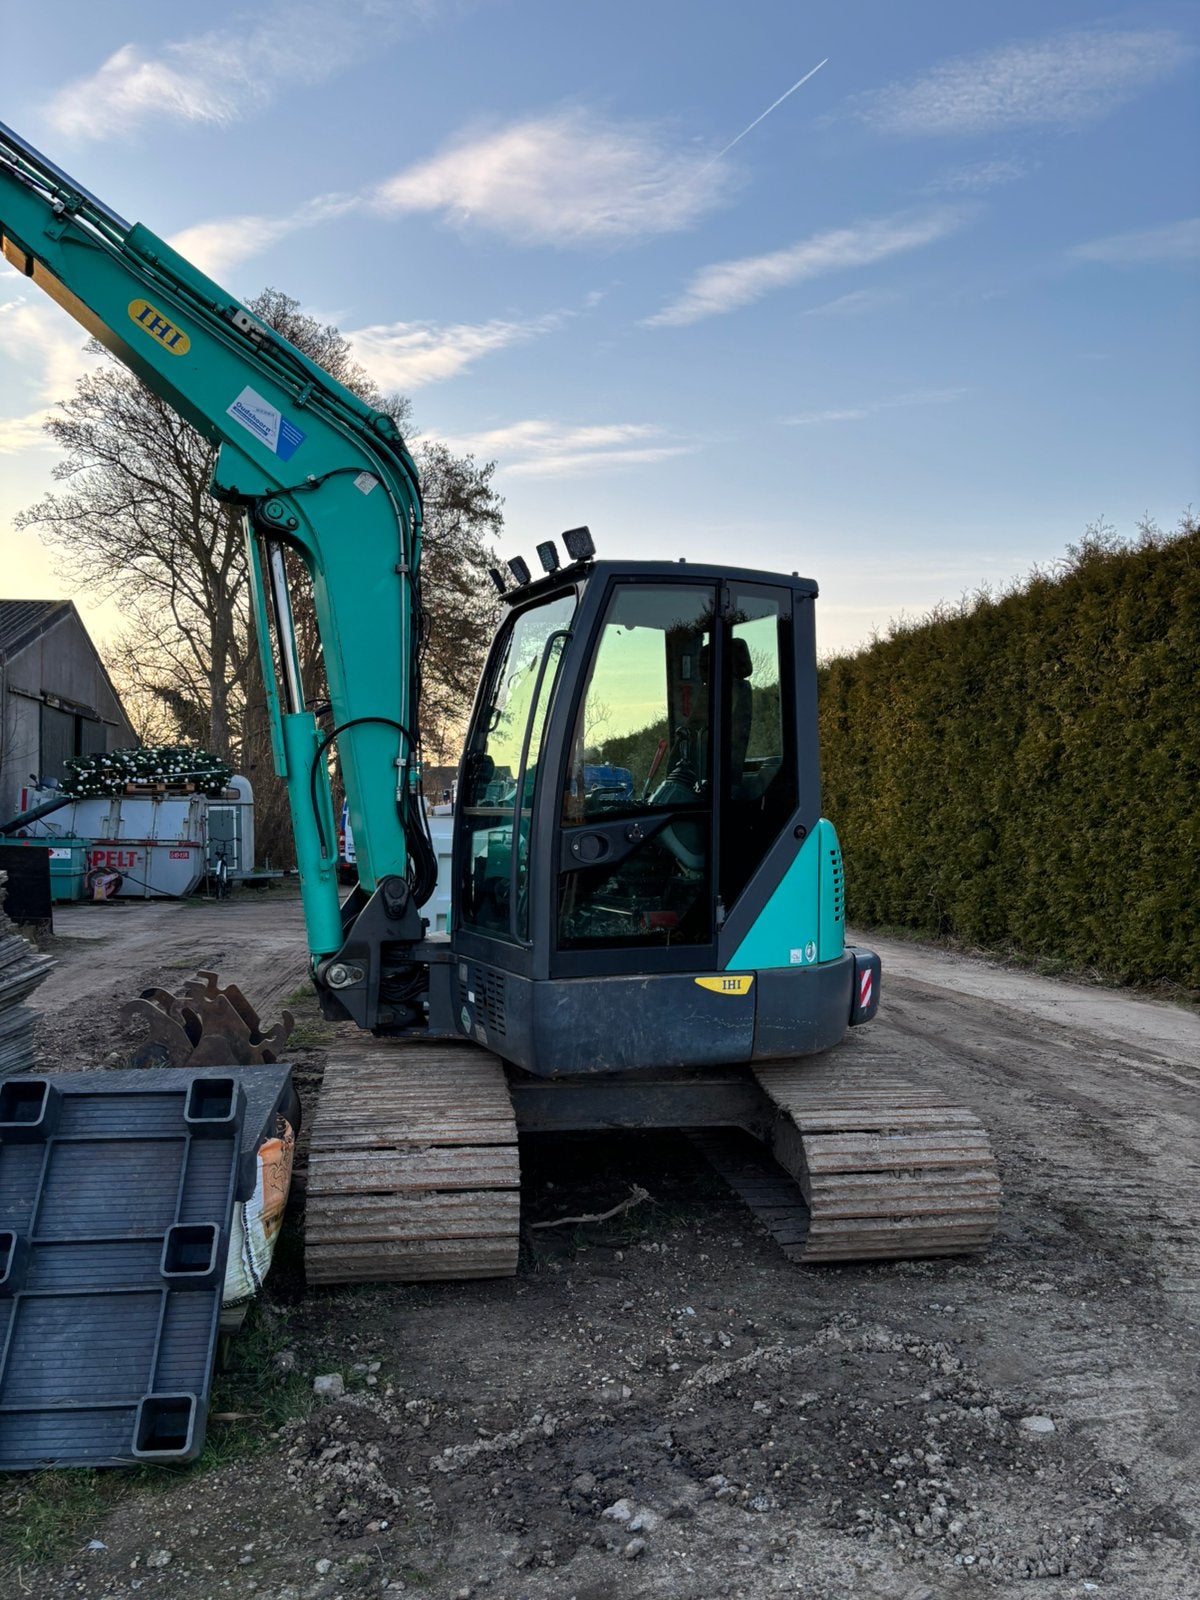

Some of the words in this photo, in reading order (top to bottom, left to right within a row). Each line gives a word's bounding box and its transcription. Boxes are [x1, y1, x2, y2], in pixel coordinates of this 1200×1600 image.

[136, 305, 184, 349] IHI
[236, 401, 272, 433] Oudshoorn
[722, 979, 741, 990] IHI
